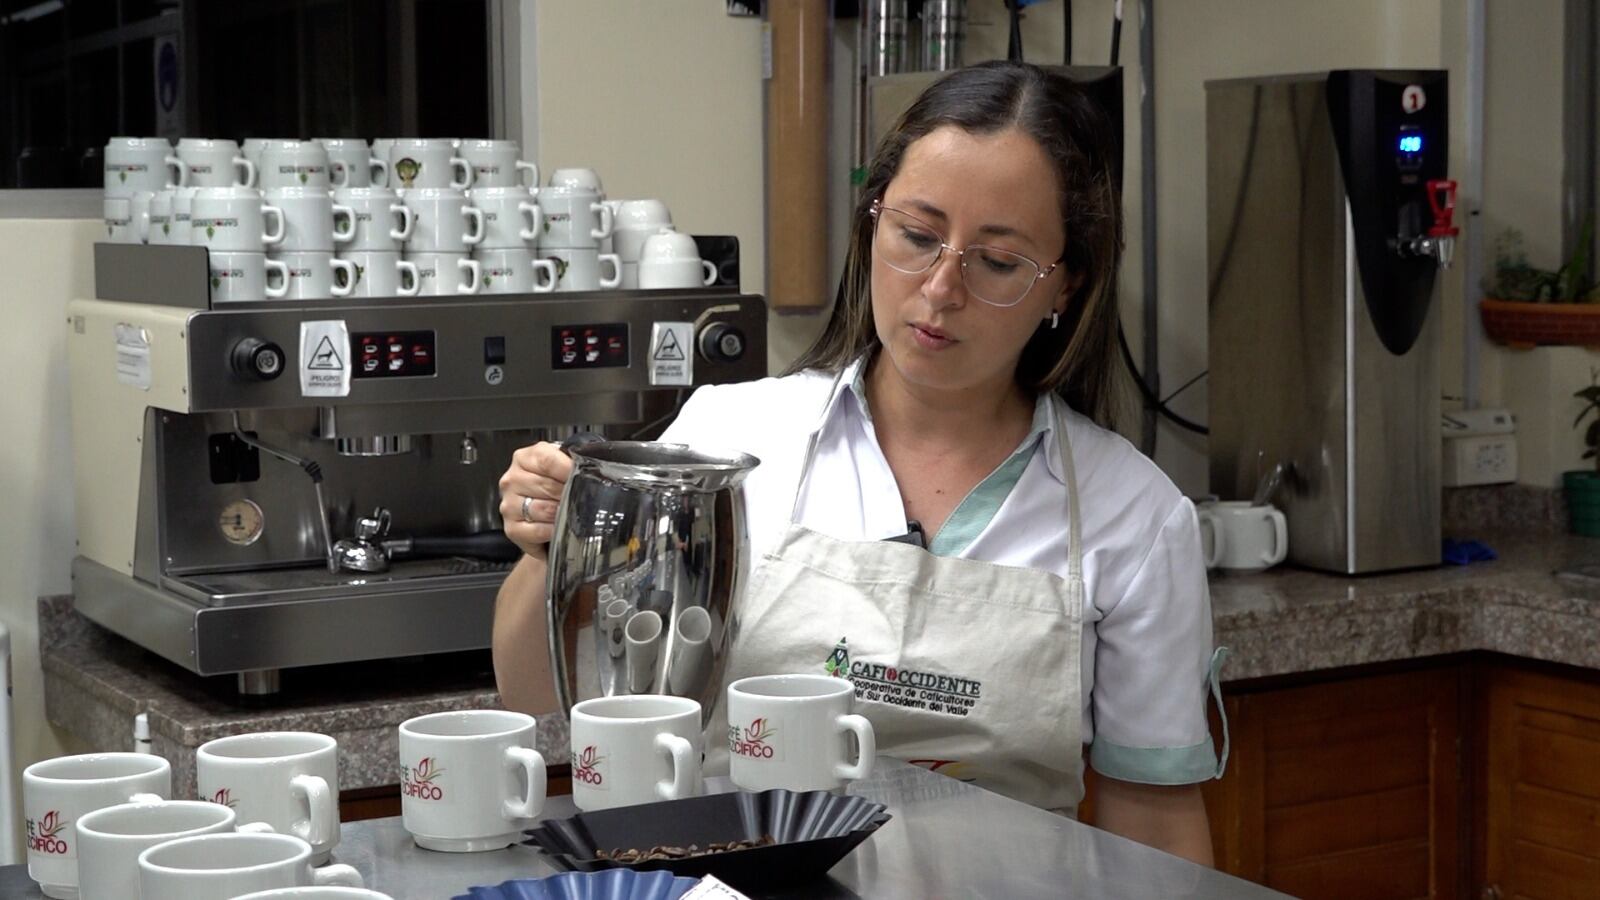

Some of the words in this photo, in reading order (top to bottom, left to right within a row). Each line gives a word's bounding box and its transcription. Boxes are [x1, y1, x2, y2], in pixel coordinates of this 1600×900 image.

[866, 690, 880, 701] Sur
[883, 694, 926, 709] Occidente
[929, 702, 943, 713] del
[946, 705, 968, 717] Valle
[904, 688, 916, 698] de
[920, 690, 976, 707] Caficultores
